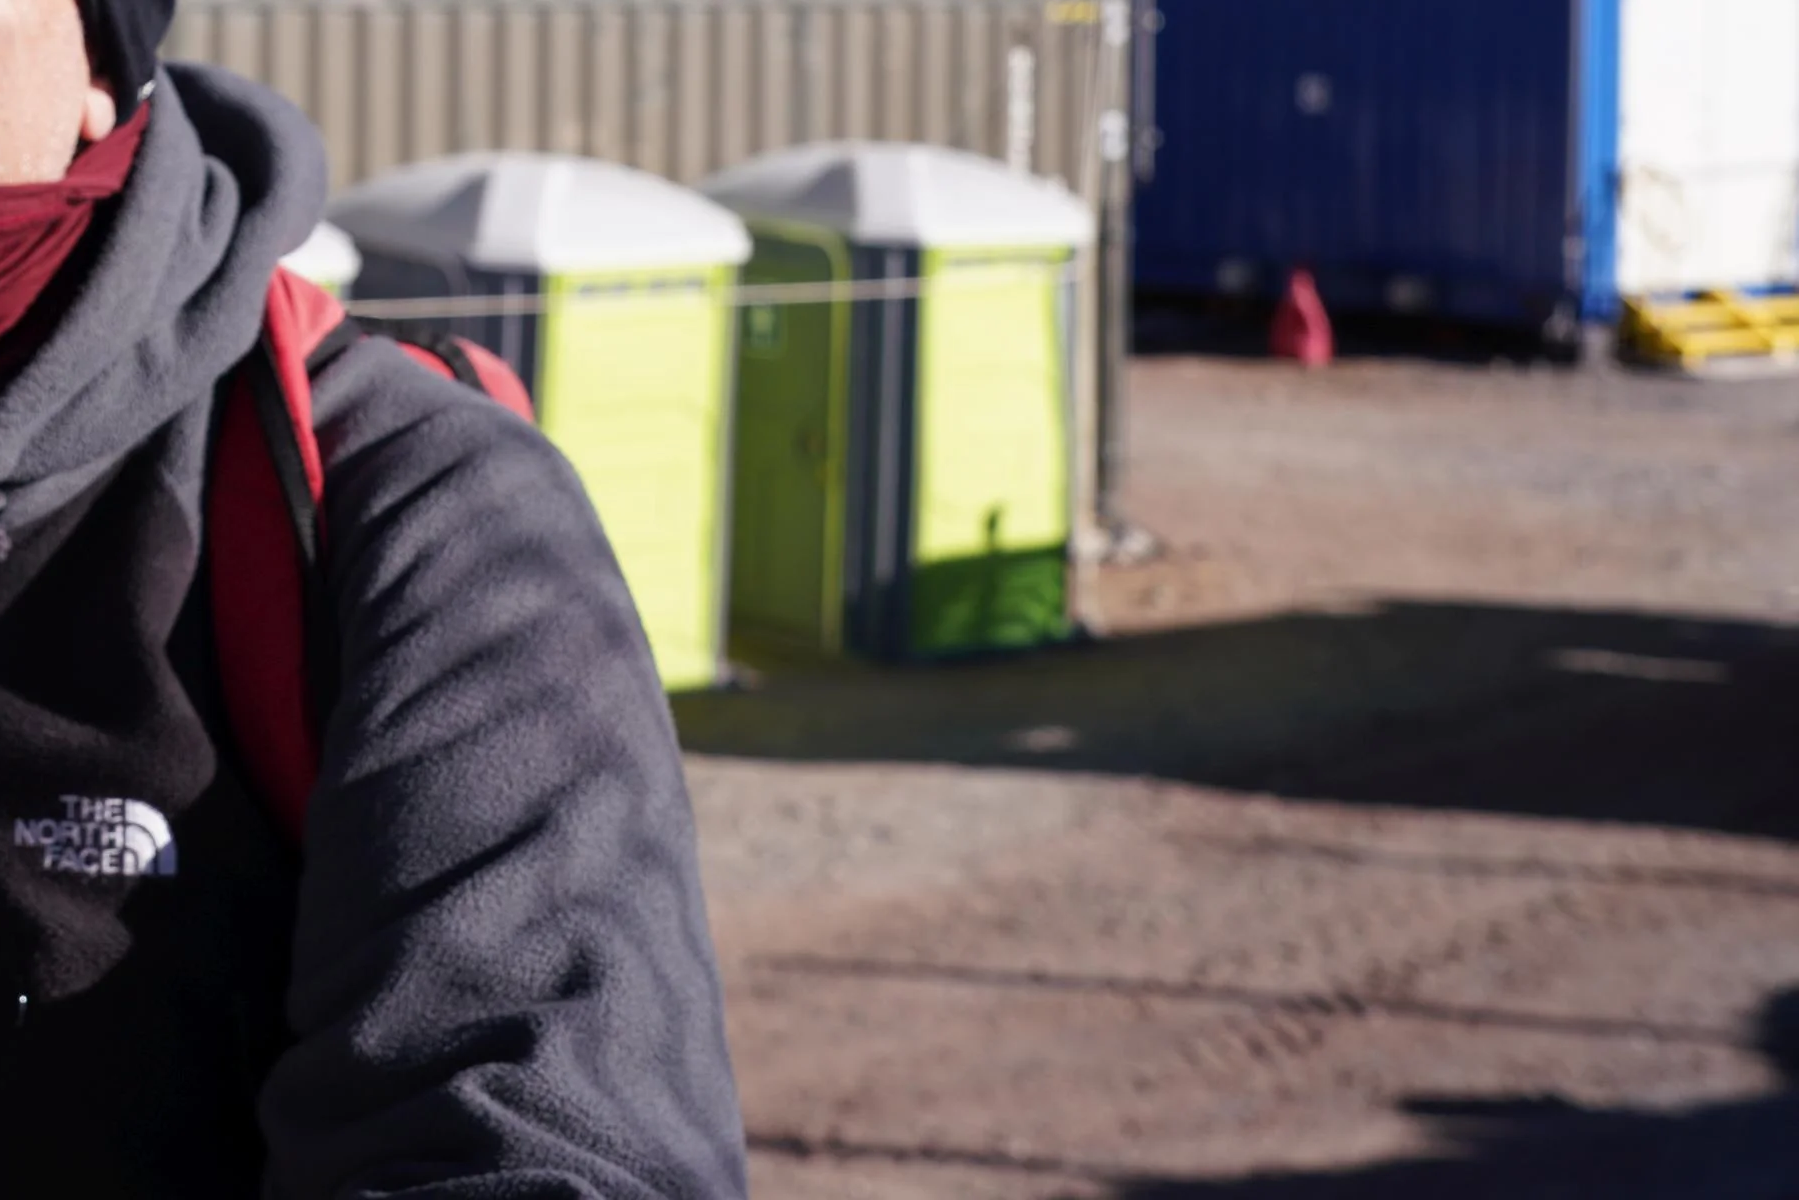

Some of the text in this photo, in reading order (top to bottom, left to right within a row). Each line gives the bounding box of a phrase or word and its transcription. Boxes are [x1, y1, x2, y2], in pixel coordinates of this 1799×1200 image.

[59, 794, 124, 823] THE
[13, 817, 125, 848] NORTH
[43, 845, 124, 876] FACE
